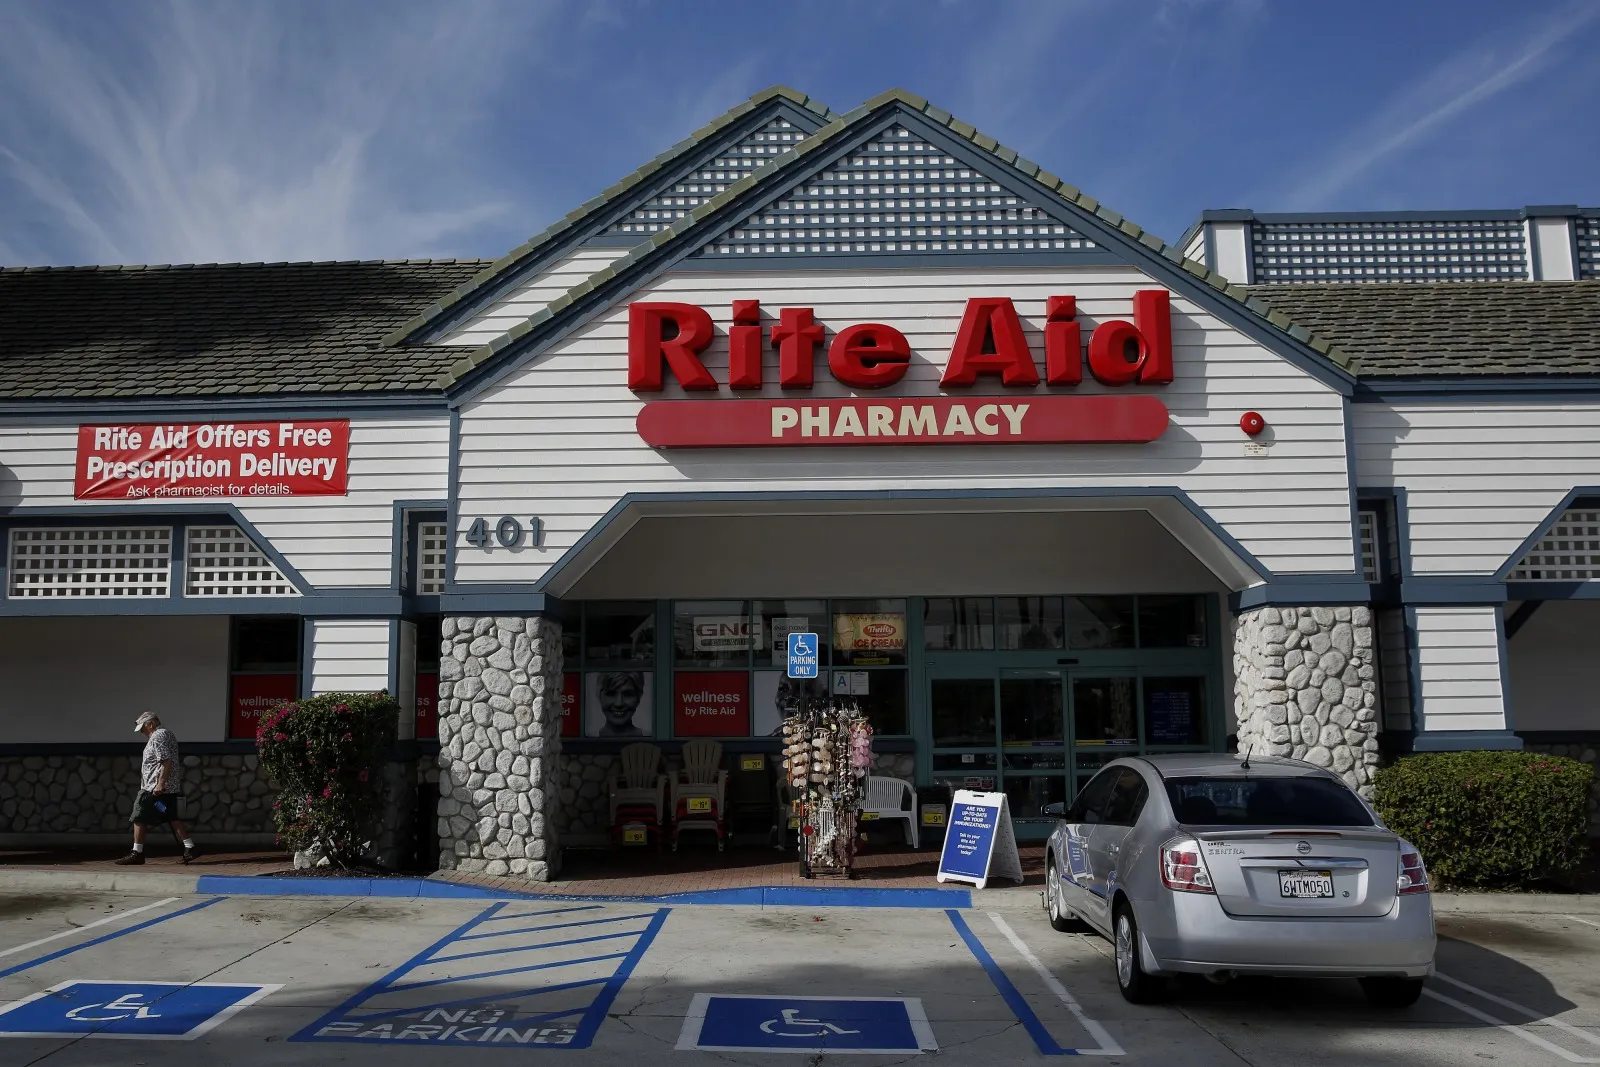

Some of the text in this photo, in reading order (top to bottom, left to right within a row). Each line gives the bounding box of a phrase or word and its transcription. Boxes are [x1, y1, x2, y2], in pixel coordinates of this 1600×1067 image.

[628, 290, 1174, 391] Rite Aid
[771, 403, 1030, 438] PHARMACY
[94, 423, 332, 451] Rite Aid Offers Free
[86, 453, 338, 483] Prescription Delivery
[126, 484, 293, 499] Ask pharmacist for details.
[465, 515, 541, 549] 401
[696, 622, 761, 637] GNC
[867, 624, 894, 634] Thrifty
[854, 638, 904, 648] ICE CREAM
[790, 656, 816, 665] PARKING
[795, 666, 811, 675] ONLY
[837, 675, 847, 687] A
[239, 695, 289, 706] wellness
[681, 690, 741, 703] wellness
[241, 709, 252, 719] by
[685, 706, 736, 717] by Rite Aid
[1283, 880, 1330, 893] 6WTM050
[421, 1006, 504, 1023] NO
[312, 1025, 578, 1044] PARKING
